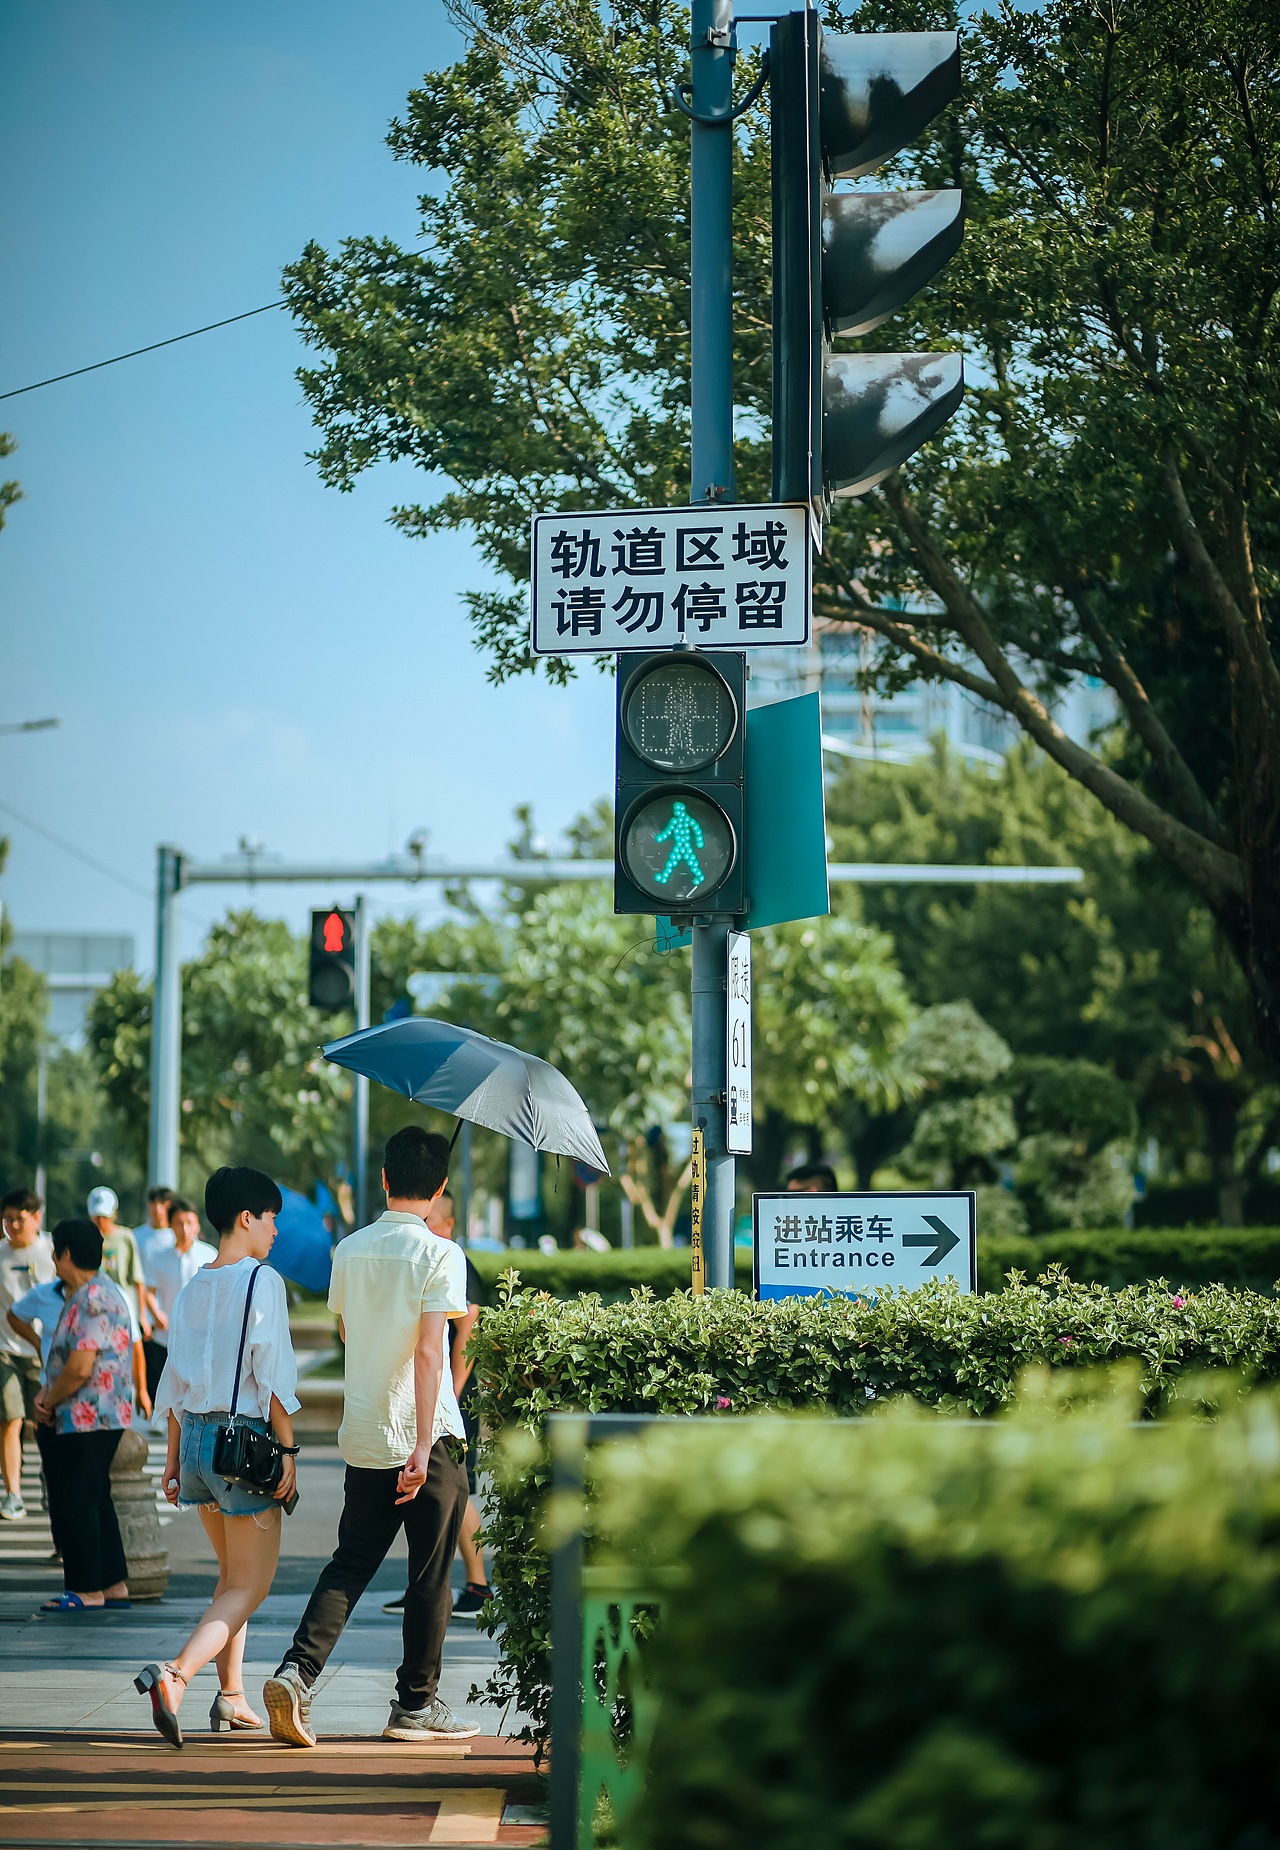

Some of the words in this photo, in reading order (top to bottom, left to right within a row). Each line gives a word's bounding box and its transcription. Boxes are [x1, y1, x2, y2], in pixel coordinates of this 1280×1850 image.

[550, 520, 789, 578] 轨道区域
[550, 580, 787, 636] 请勿停留
[732, 1018, 747, 1068] 61
[773, 1214, 894, 1244] 进站乘车
[774, 1248, 895, 1268] Entrance
